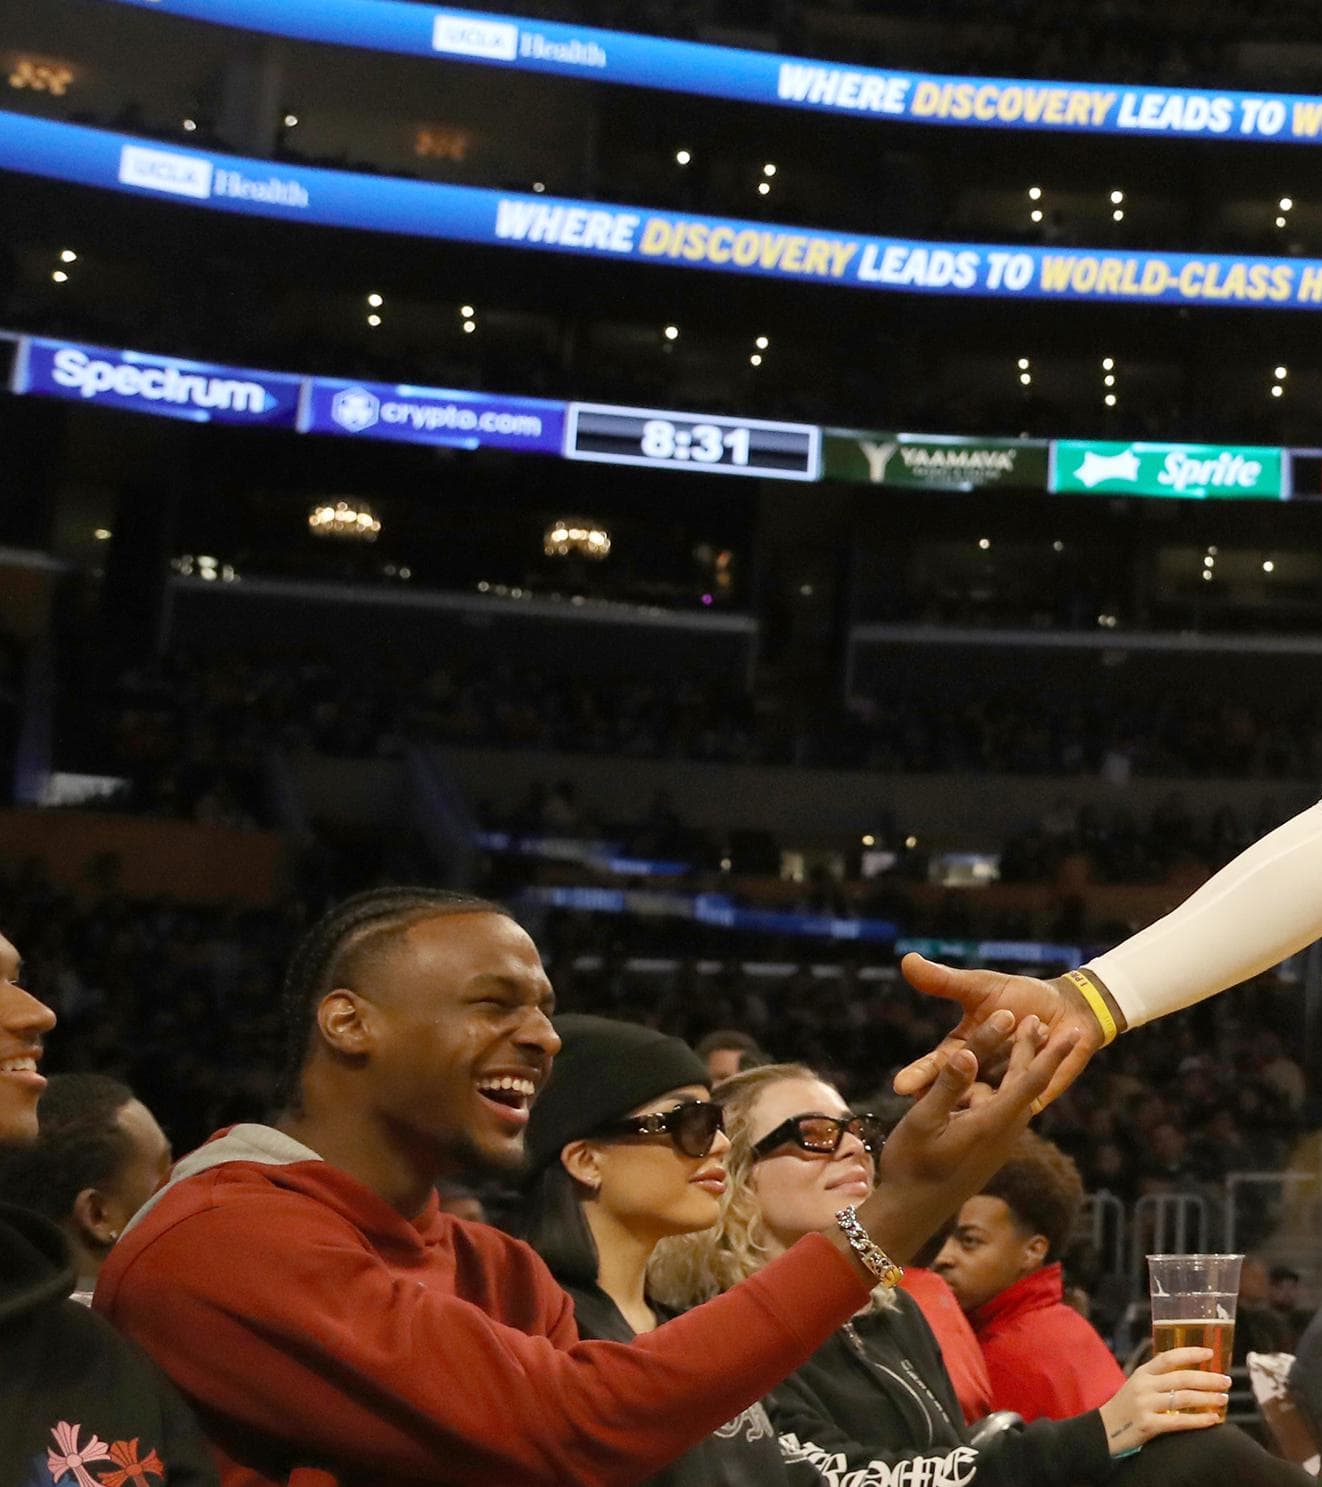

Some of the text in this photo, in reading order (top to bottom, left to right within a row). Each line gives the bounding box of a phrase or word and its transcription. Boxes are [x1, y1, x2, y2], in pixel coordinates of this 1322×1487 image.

[519, 31, 608, 68] Health
[778, 62, 911, 114] WHERE
[910, 80, 1117, 127] DISCOVERY
[1116, 92, 1234, 133] LEADS
[1239, 100, 1286, 135] TO
[213, 168, 310, 208] Health
[495, 199, 640, 253] WHERE
[638, 217, 857, 278] DISCOVERY
[856, 243, 981, 288] LEADS
[985, 252, 1036, 291] TO
[1040, 255, 1294, 302] WORLD-CLASS
[52, 349, 266, 413] Spectrum
[380, 402, 543, 438] crypto.com
[641, 419, 751, 466] 8:31
[1157, 450, 1262, 492] Sprite
